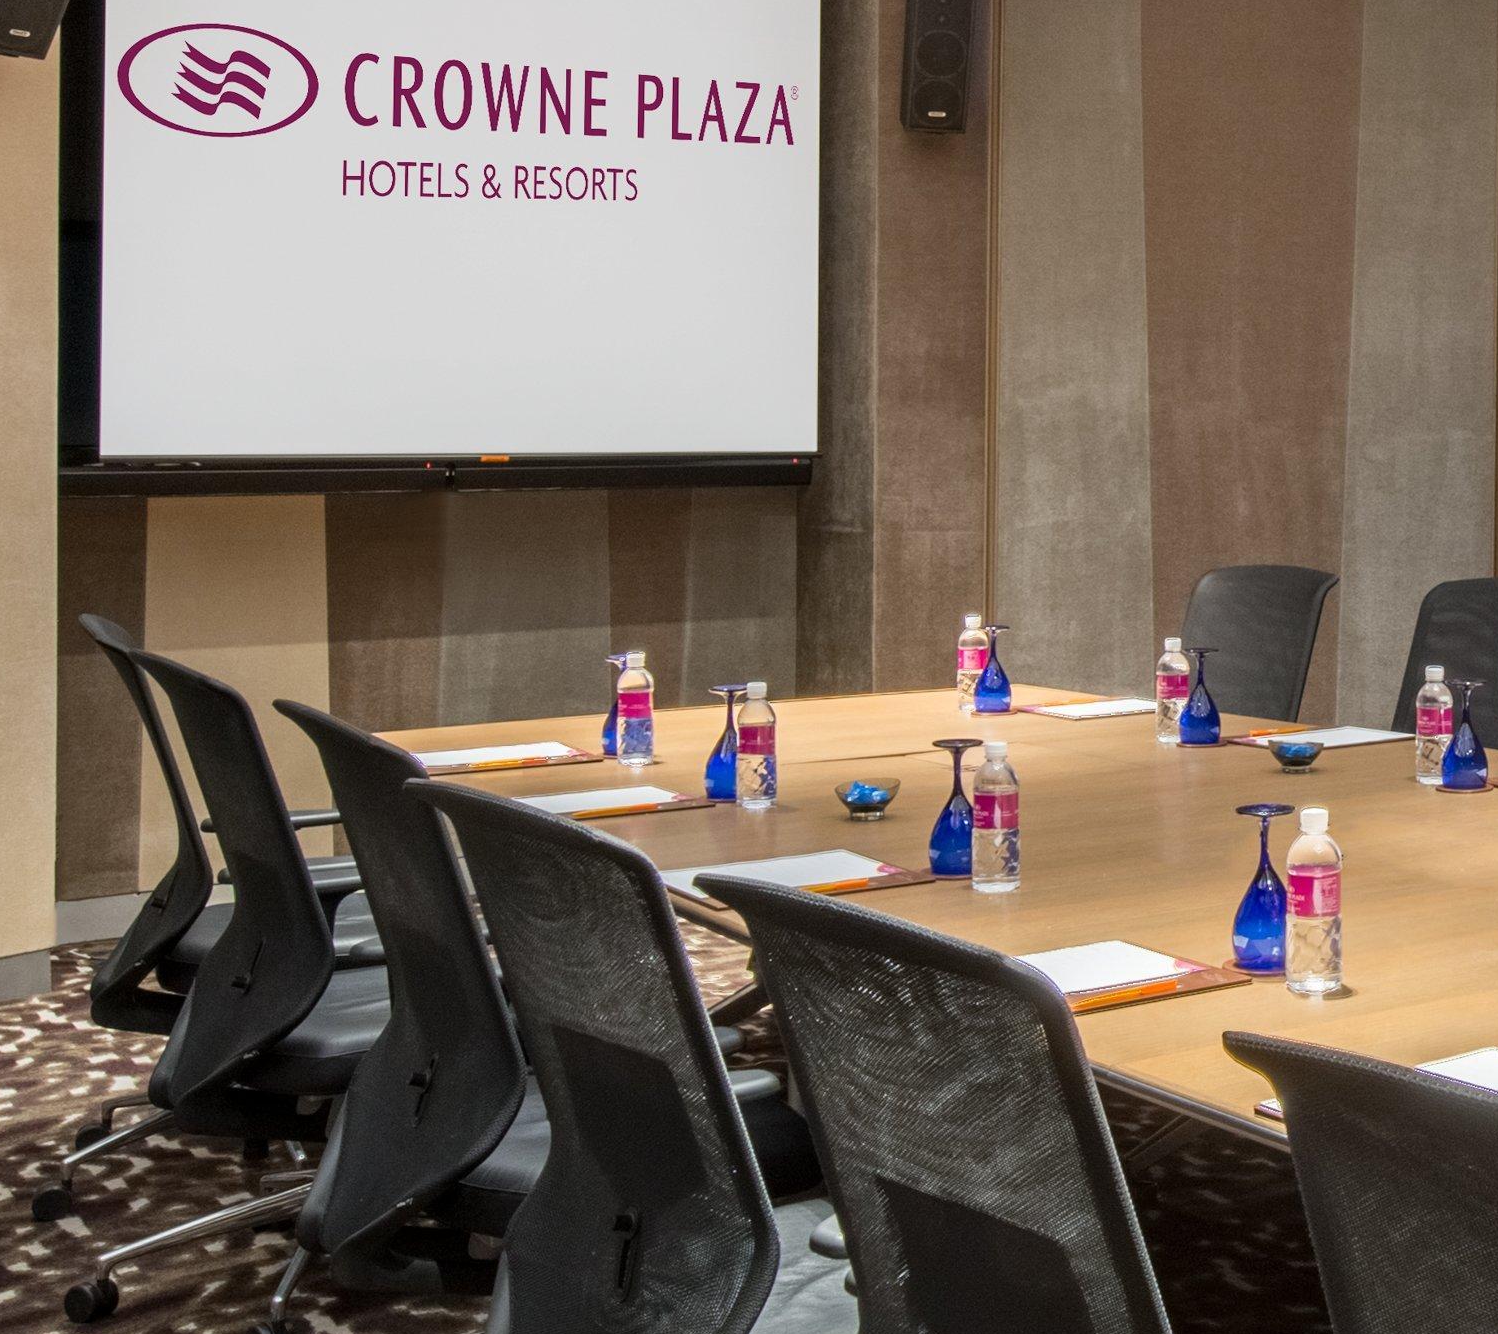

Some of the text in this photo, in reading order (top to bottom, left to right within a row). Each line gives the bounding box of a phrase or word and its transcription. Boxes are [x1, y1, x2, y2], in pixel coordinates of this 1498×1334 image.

[344, 52, 795, 146] CROWNE PLAZA
[341, 159, 638, 201] HOTELS & RESORTS
